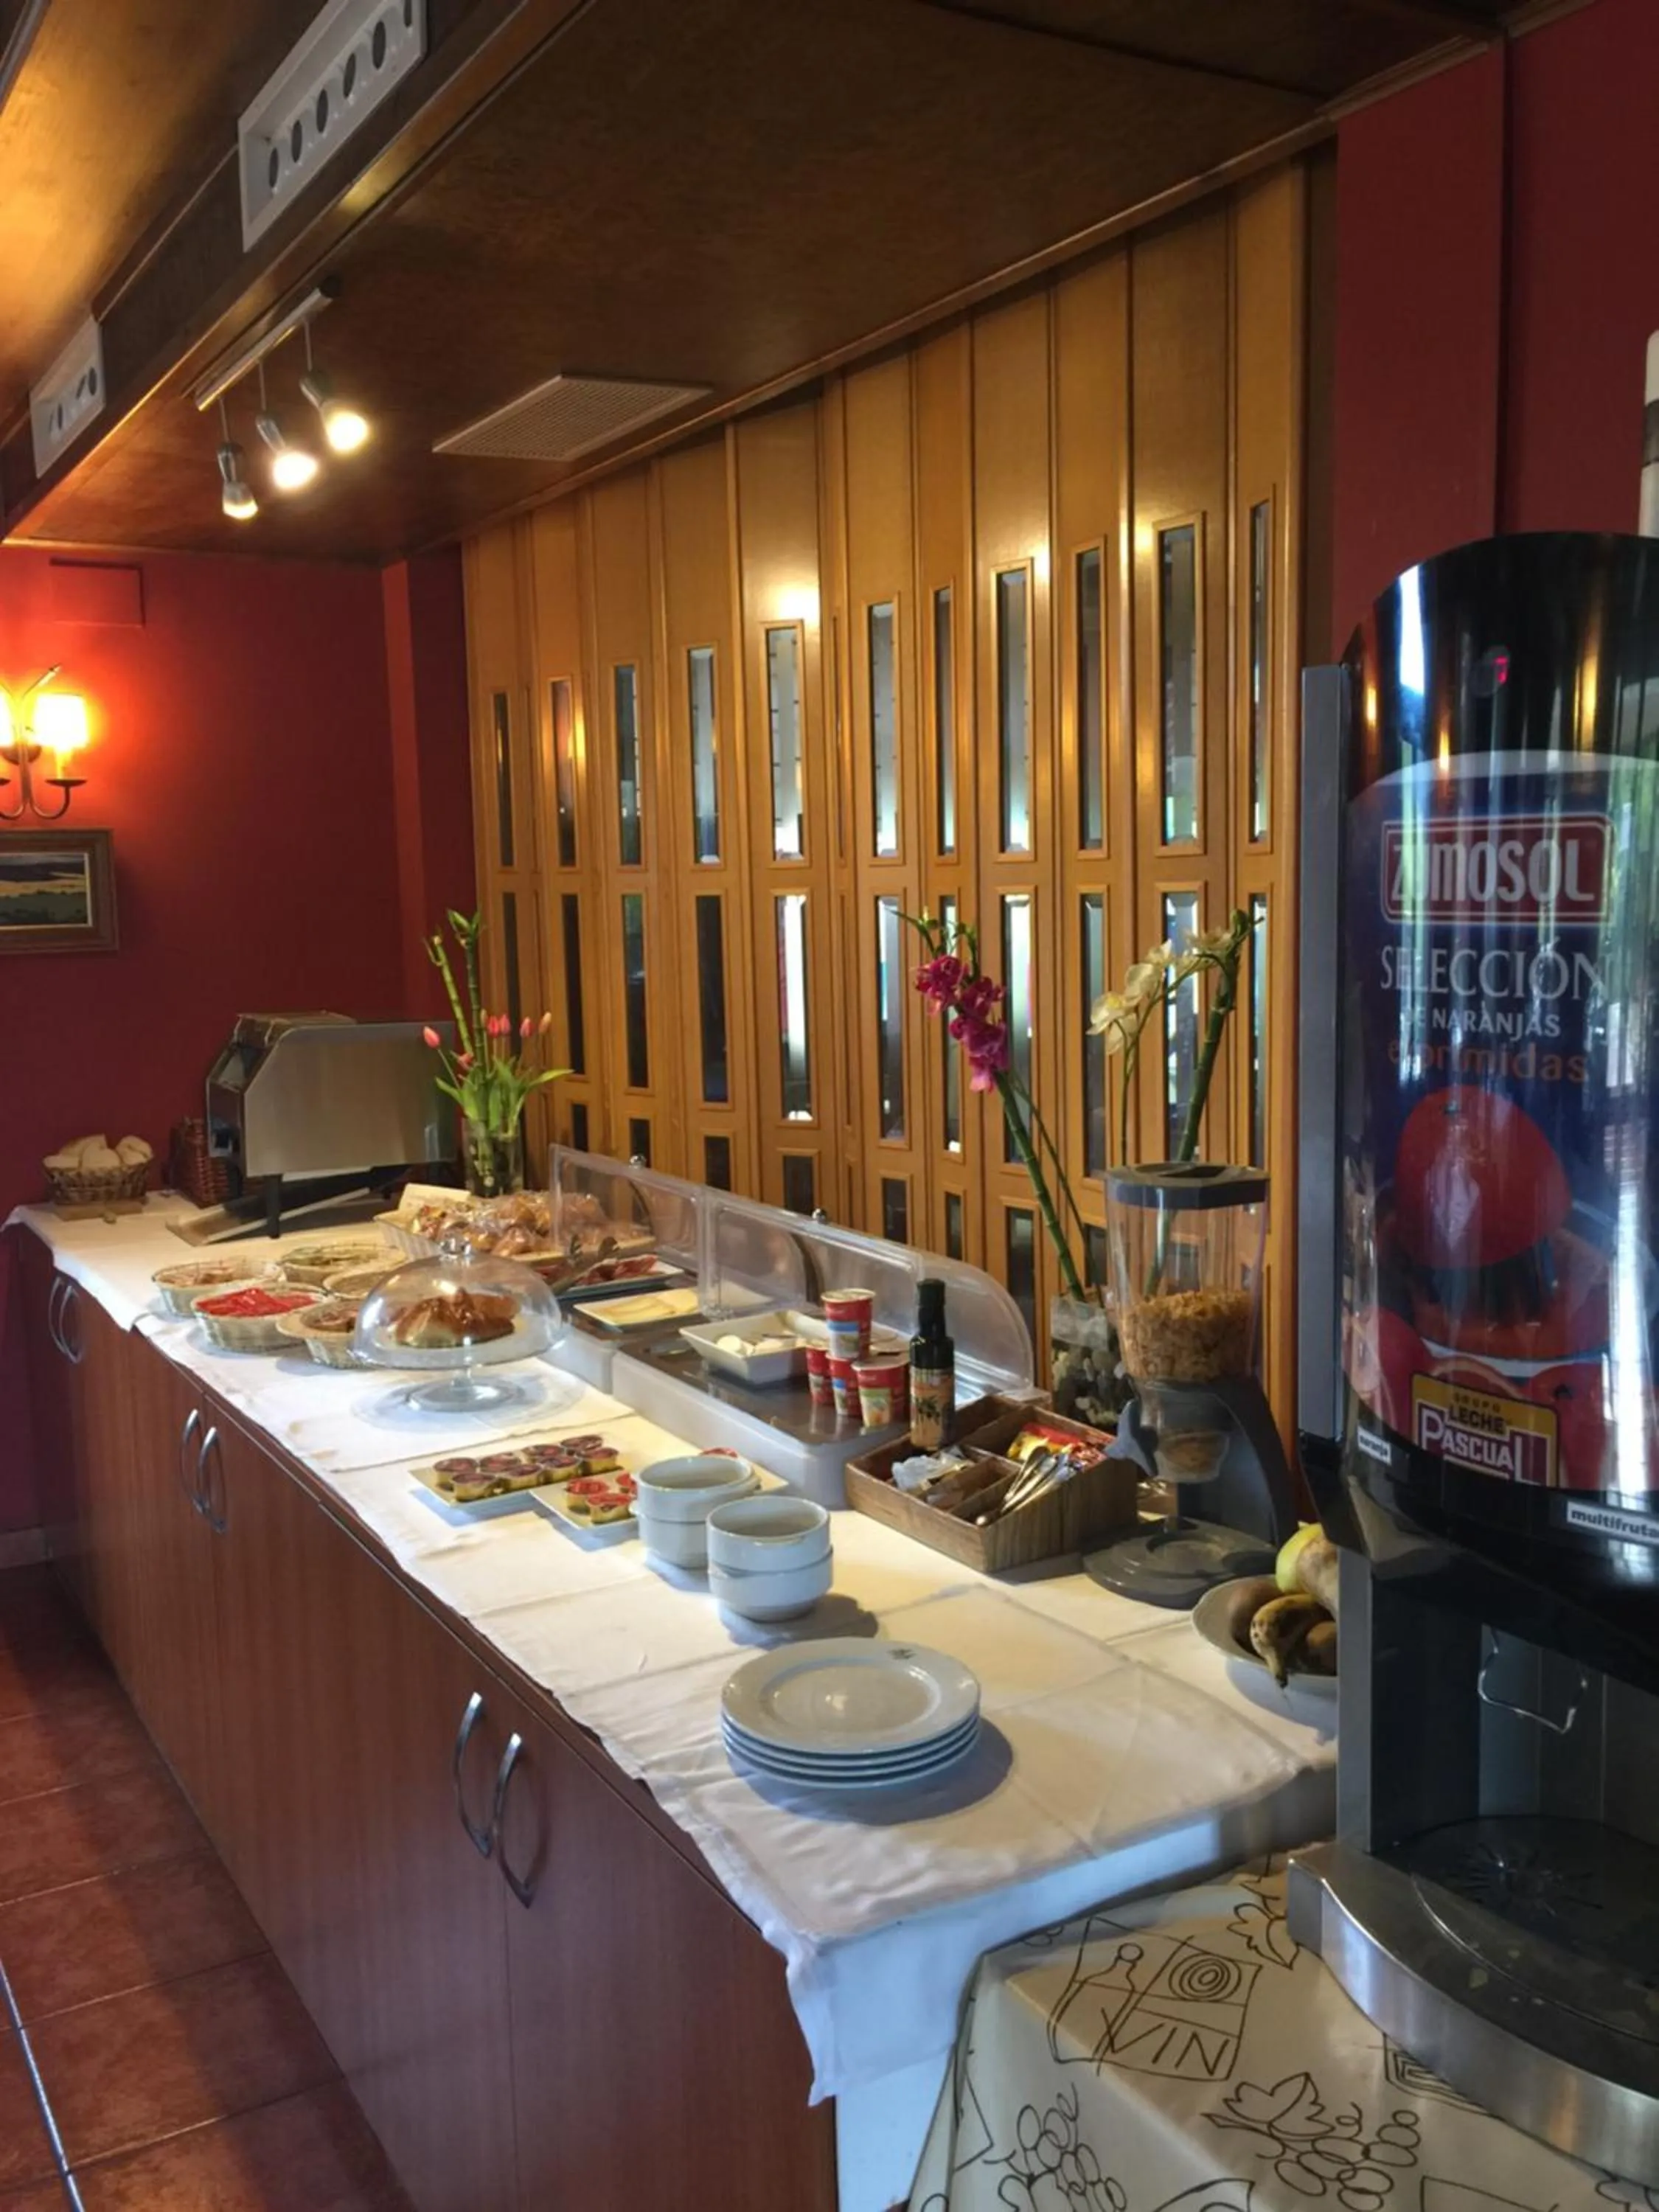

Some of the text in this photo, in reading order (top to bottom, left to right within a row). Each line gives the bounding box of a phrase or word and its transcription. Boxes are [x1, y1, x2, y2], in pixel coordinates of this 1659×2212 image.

[1432, 1008, 1561, 1040] NARANJAS
[1449, 1403, 1505, 1434] LECHE
[1101, 2007, 1231, 2077] VIN
